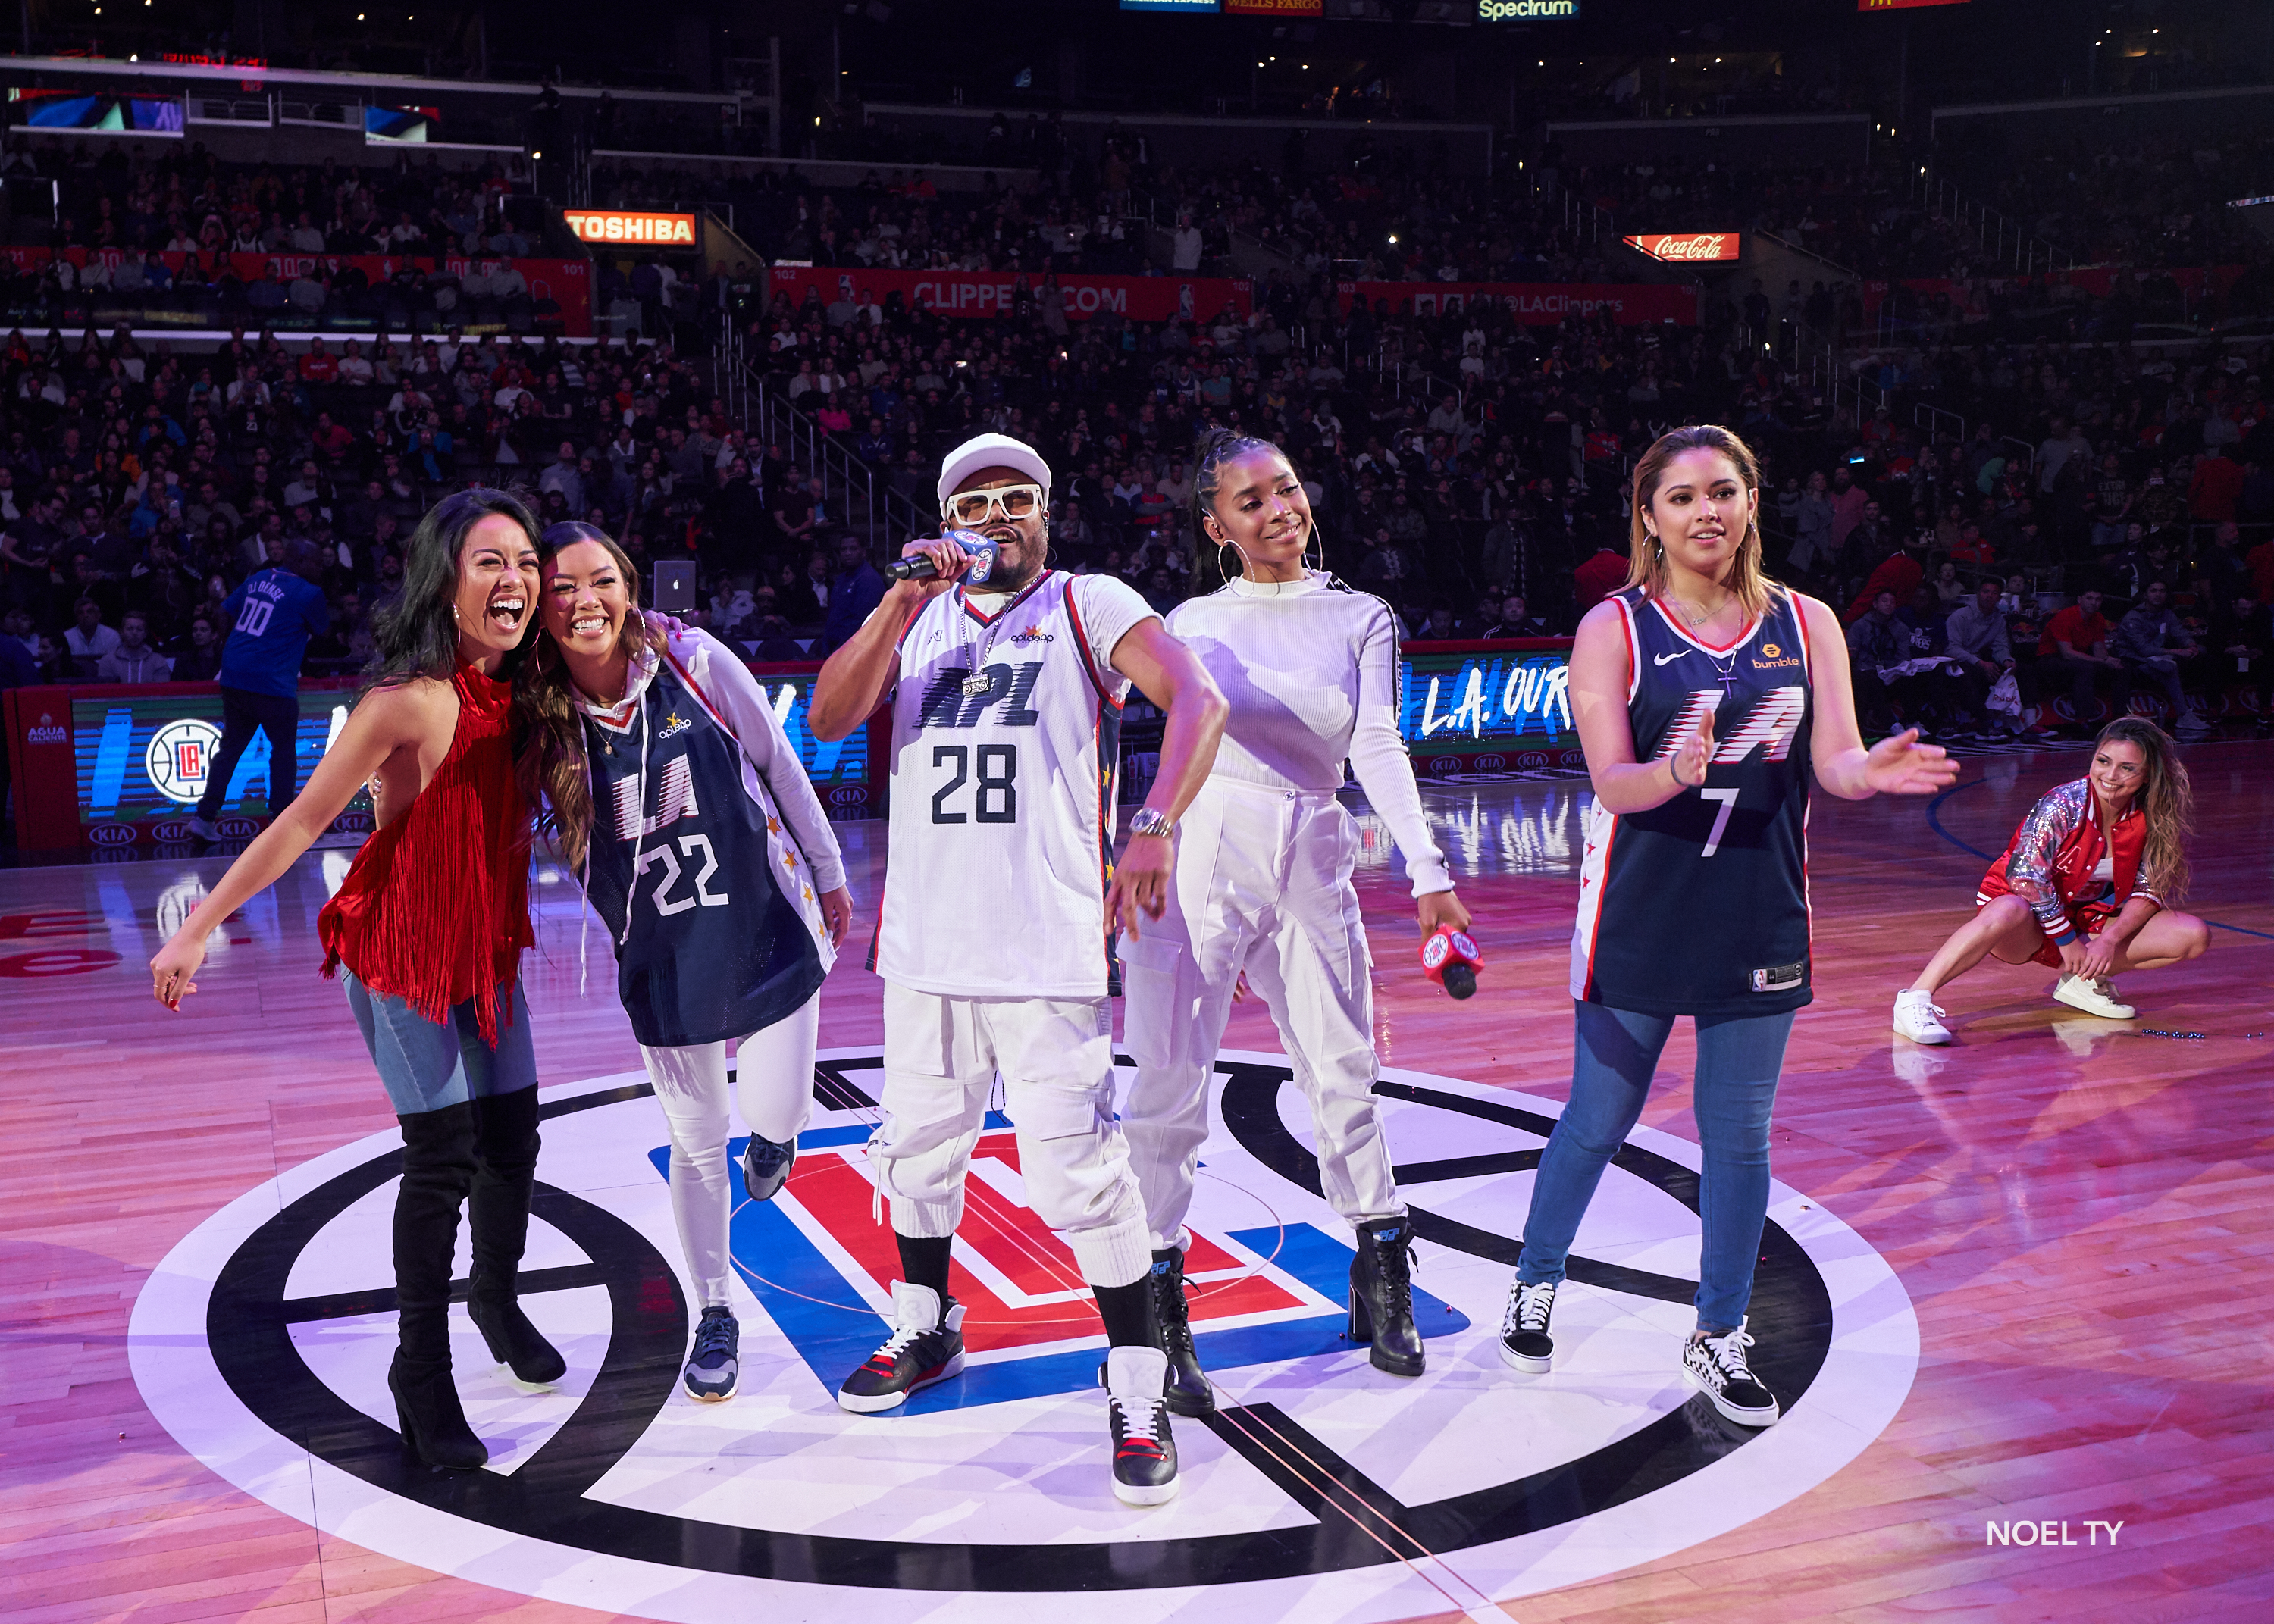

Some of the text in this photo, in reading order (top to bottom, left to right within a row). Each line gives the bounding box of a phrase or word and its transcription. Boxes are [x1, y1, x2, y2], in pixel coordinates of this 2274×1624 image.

[1228, 0, 1322, 10] WELLS FARGO
[1479, 0, 1573, 22] Spectrum
[566, 215, 693, 241] TOSHIBA
[1653, 235, 1726, 259] Coca-Cola
[563, 264, 584, 275] 101
[775, 269, 796, 280] 102
[1233, 281, 1251, 292] 102
[1337, 283, 1355, 293] 103
[235, 596, 274, 637] 00
[1752, 657, 1800, 669] bumble
[913, 662, 1044, 728] APL
[1422, 667, 1490, 739] L.A.
[28, 725, 67, 736] AGUA
[1654, 686, 1806, 765] LA
[1436, 760, 1457, 770] KIA
[1480, 757, 1501, 767] KIA
[1524, 755, 1543, 765] KIA
[932, 744, 1016, 824] 28
[612, 753, 700, 843] LA
[836, 790, 861, 802] KIA
[221, 821, 253, 836] KIA
[1701, 788, 1740, 857] 7
[97, 828, 129, 842] KIA
[633, 834, 729, 917] 22
[1123, 1363, 1162, 1388] Y-3
